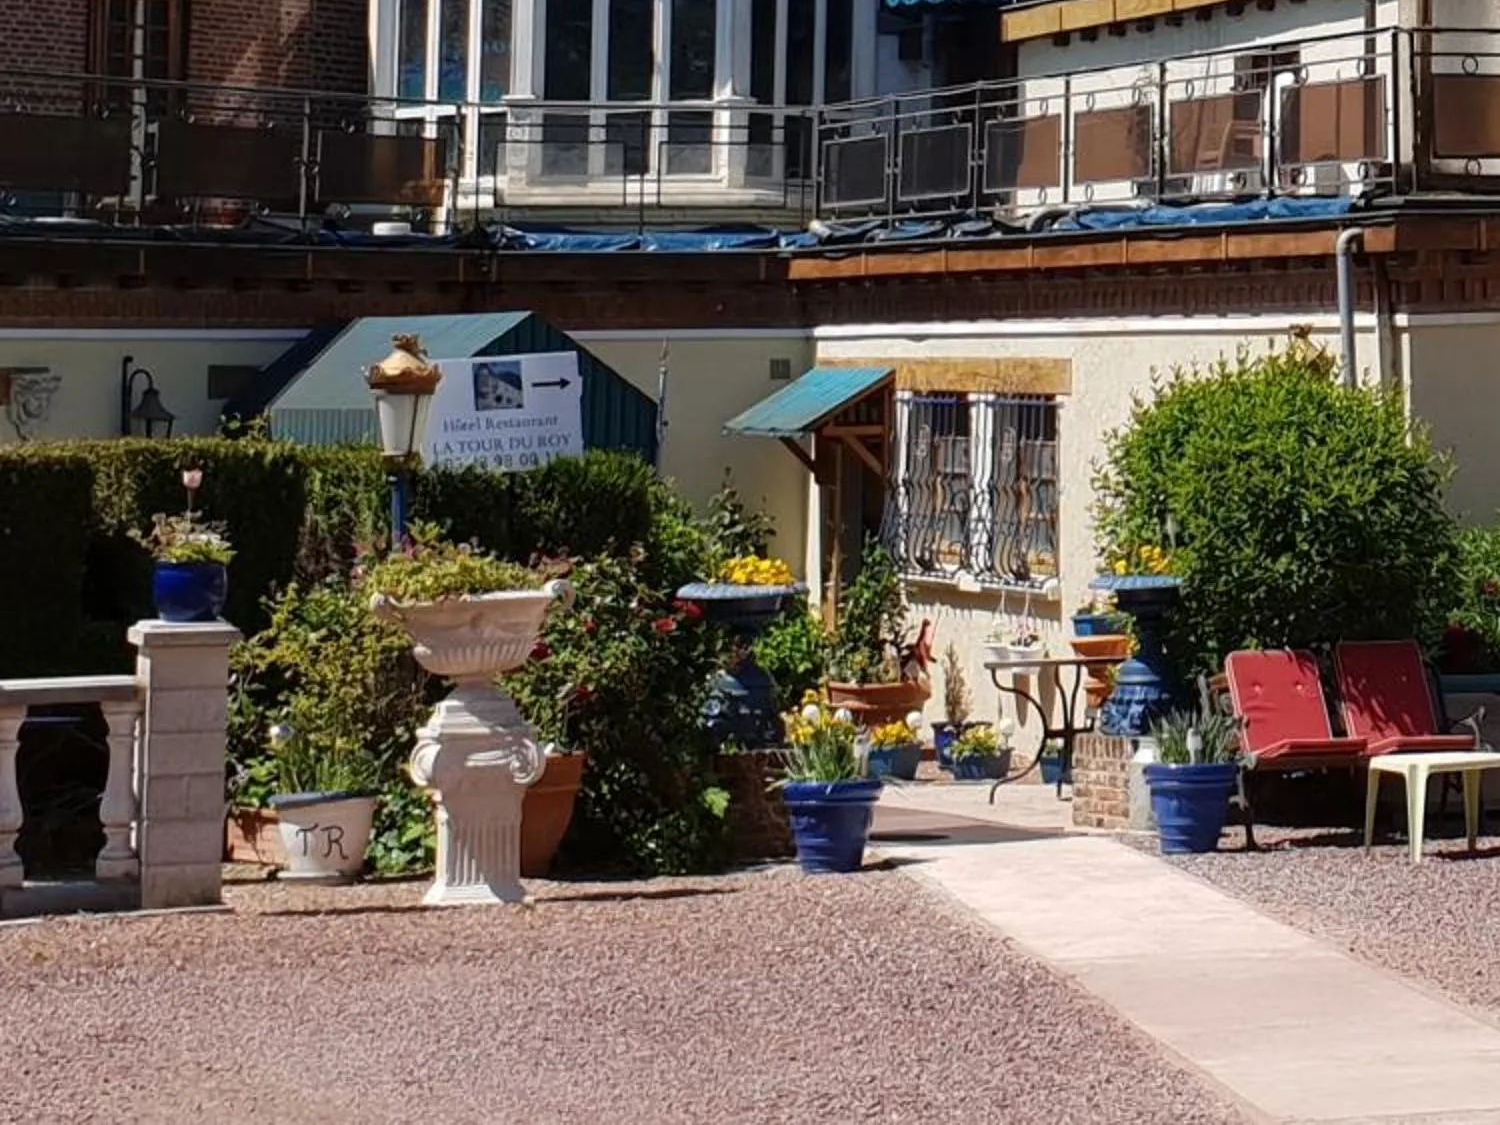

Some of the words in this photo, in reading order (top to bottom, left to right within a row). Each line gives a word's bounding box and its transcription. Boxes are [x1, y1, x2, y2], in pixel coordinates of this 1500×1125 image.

[443, 416, 481, 433] Hôtel
[485, 415, 558, 431] Restaurant
[432, 441, 454, 457] LA
[458, 438, 505, 455] TOUR
[509, 435, 534, 450] DU
[537, 432, 572, 448] ROY
